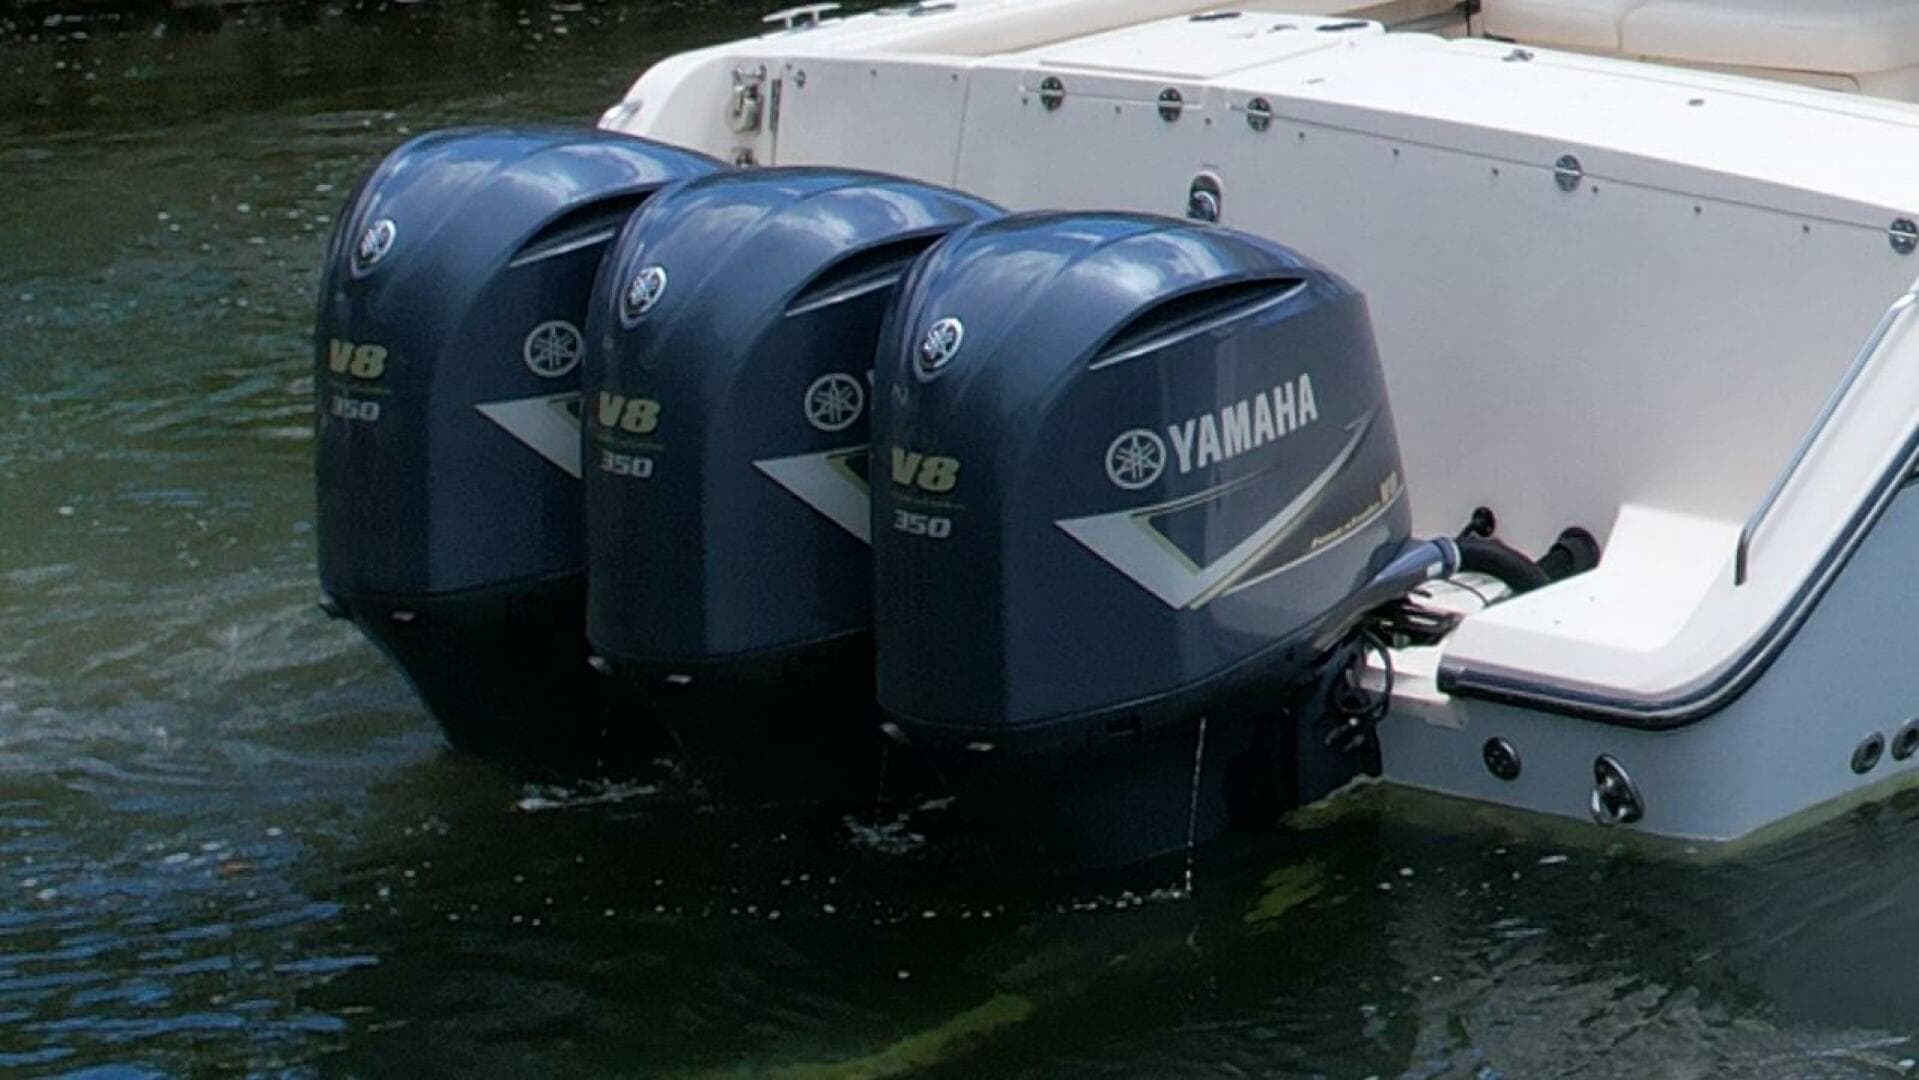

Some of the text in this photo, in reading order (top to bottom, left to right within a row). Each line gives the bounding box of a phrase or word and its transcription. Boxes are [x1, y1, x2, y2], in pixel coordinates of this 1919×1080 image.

[329, 339, 388, 379] V8
[599, 390, 660, 432] V8
[1168, 373, 1319, 475] YAMAHA
[600, 450, 653, 477] 350
[891, 447, 960, 492] V8
[894, 509, 951, 538] 350
